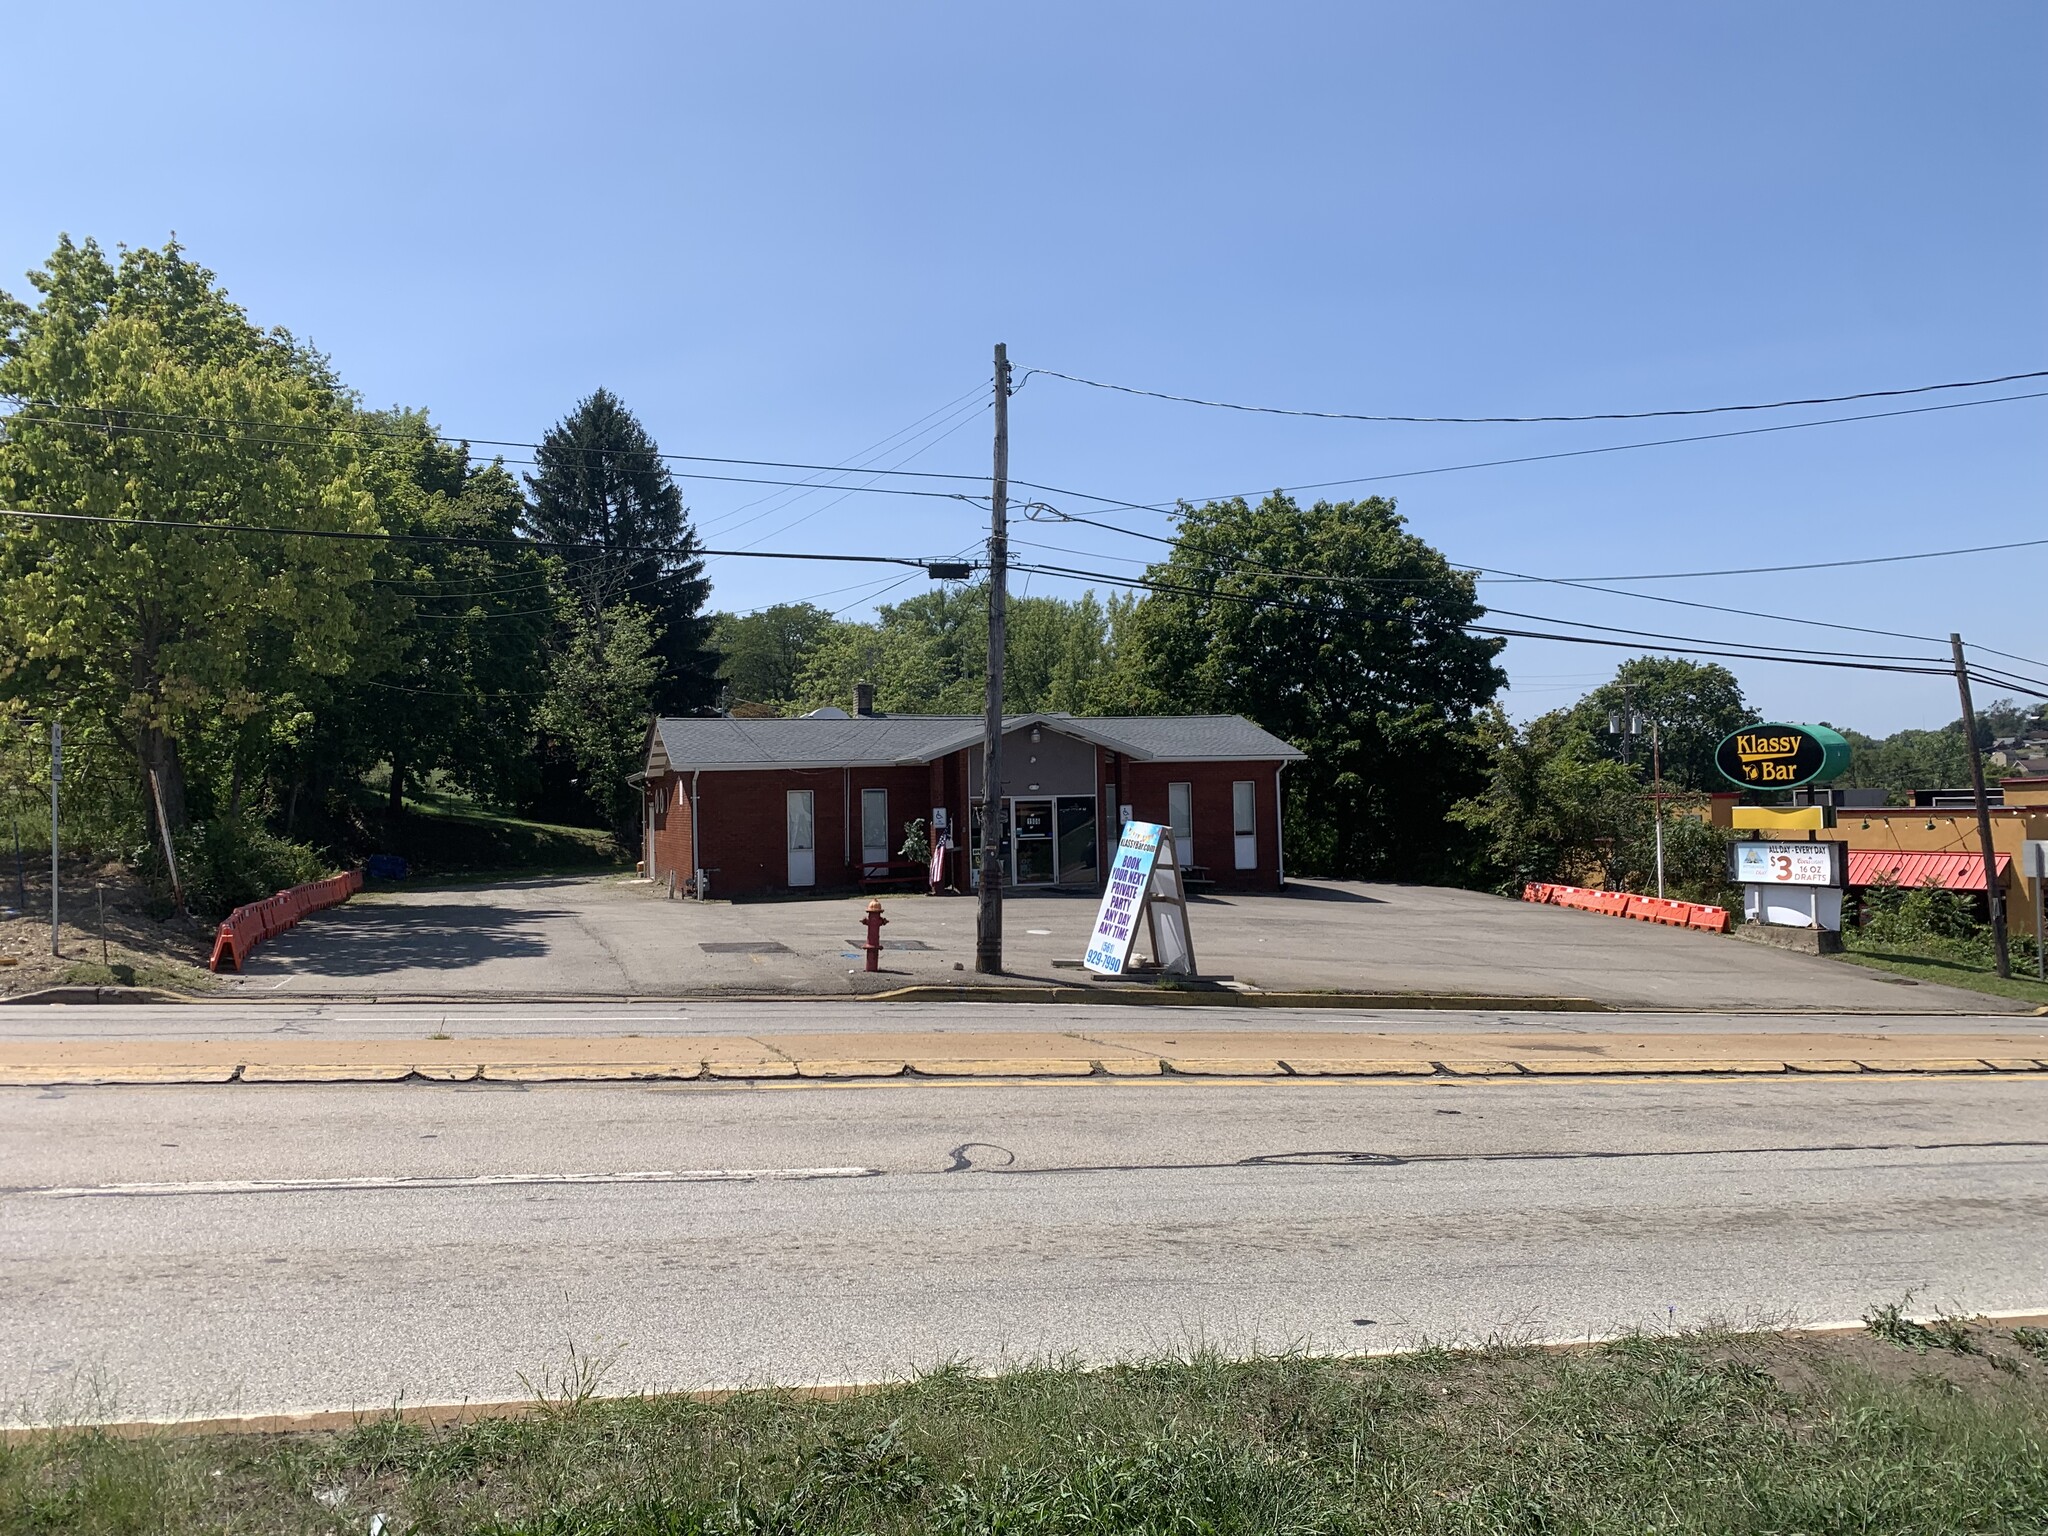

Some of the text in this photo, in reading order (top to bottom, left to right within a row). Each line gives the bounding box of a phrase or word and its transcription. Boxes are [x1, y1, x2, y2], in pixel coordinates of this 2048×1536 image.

[1736, 734, 1802, 756] Klassy
[1761, 761, 1797, 780] Bar
[1768, 845, 1780, 854] ALL
[1779, 845, 1791, 854] DAY
[1795, 845, 1814, 855] EVERY
[1814, 846, 1826, 855] DAY
[1121, 855, 1142, 871] BOOK
[1809, 865, 1822, 874] OZ
[1111, 867, 1147, 886] YOUR NEXT
[1794, 873, 1827, 882] DRAFTS
[1110, 881, 1139, 899] PRIVATE
[1110, 895, 1132, 912] PARTY
[1103, 908, 1132, 927] ANY DAY
[1098, 921, 1129, 941] ANY TIME
[1086, 949, 1121, 972] 929-7990
